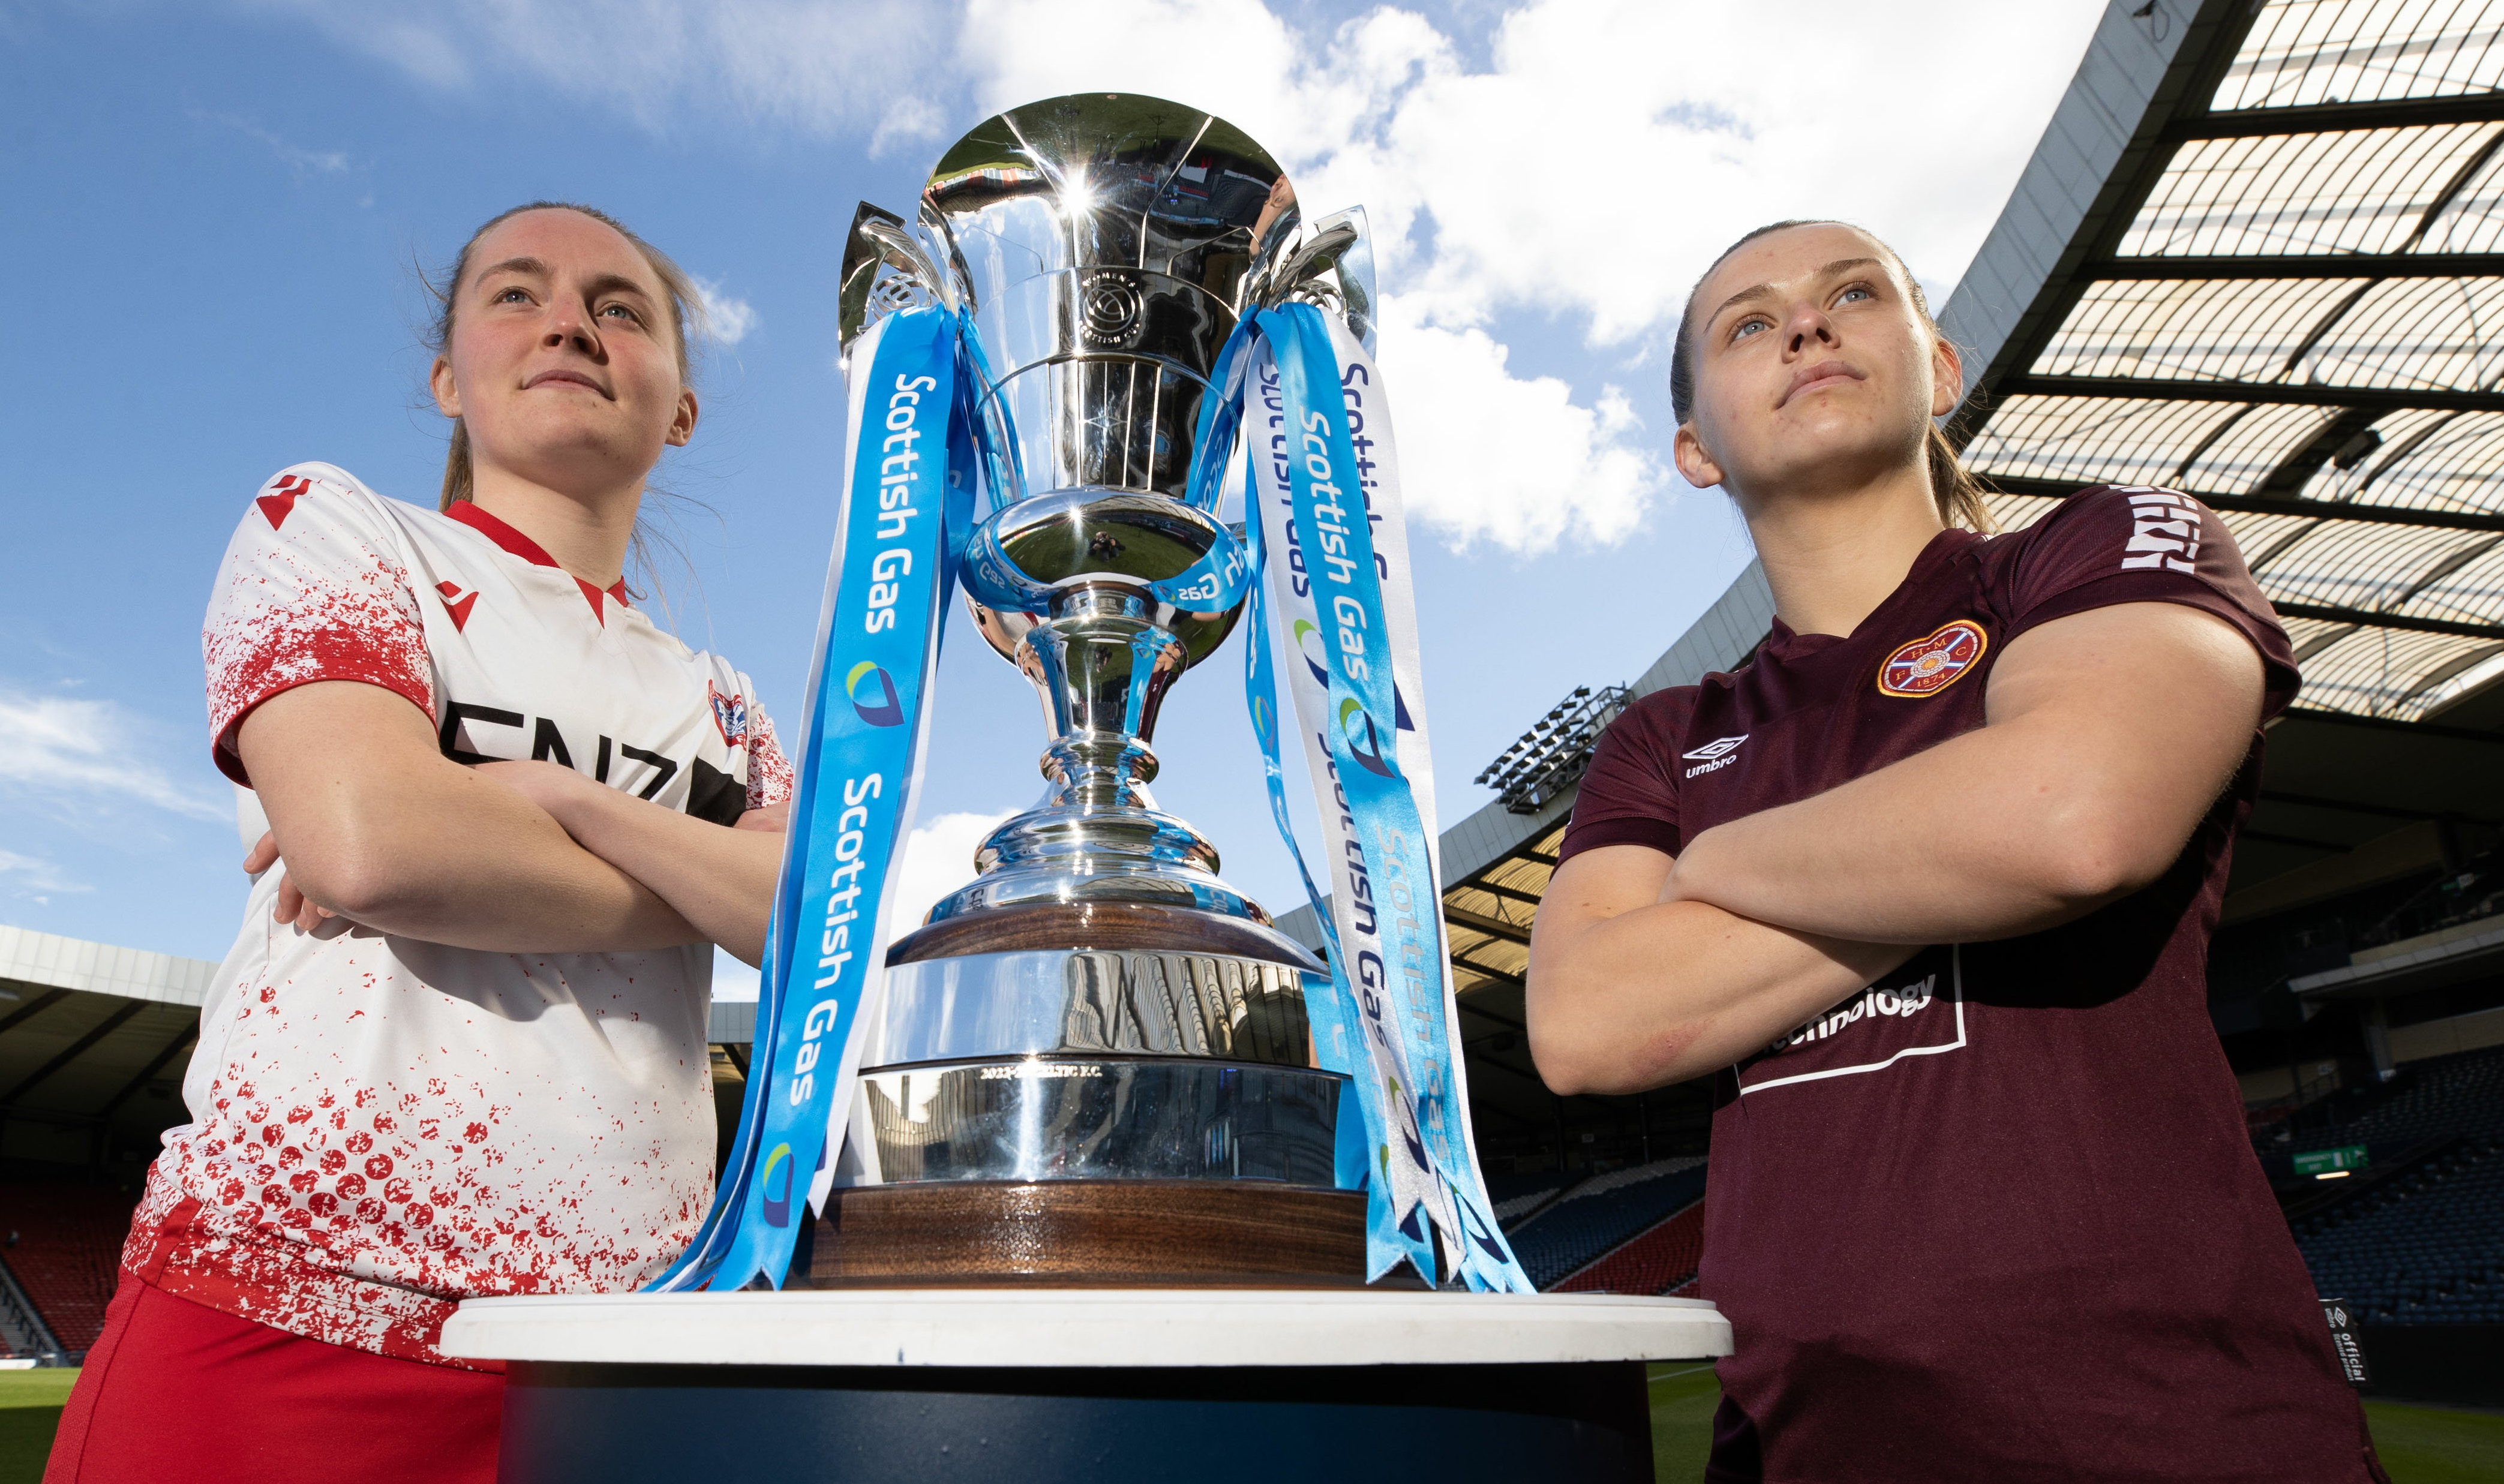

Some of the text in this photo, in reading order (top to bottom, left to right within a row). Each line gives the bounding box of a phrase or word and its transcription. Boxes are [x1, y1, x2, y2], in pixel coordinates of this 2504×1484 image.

[866, 372, 936, 634] Scottish Gas
[1299, 404, 1369, 683] Scottish Gas
[1916, 672, 1947, 687] 1874
[1686, 755, 1737, 779] umbro
[789, 773, 881, 1107] Scottish Gas
[1358, 950, 1391, 1050] Gas
[1376, 824, 1451, 1162] Scottish Gas
[1764, 974, 1936, 1055] chnology
[2325, 1308, 2337, 1329] umbro
[2341, 1333, 2366, 1381] official
[2340, 1358, 2355, 1381] product
